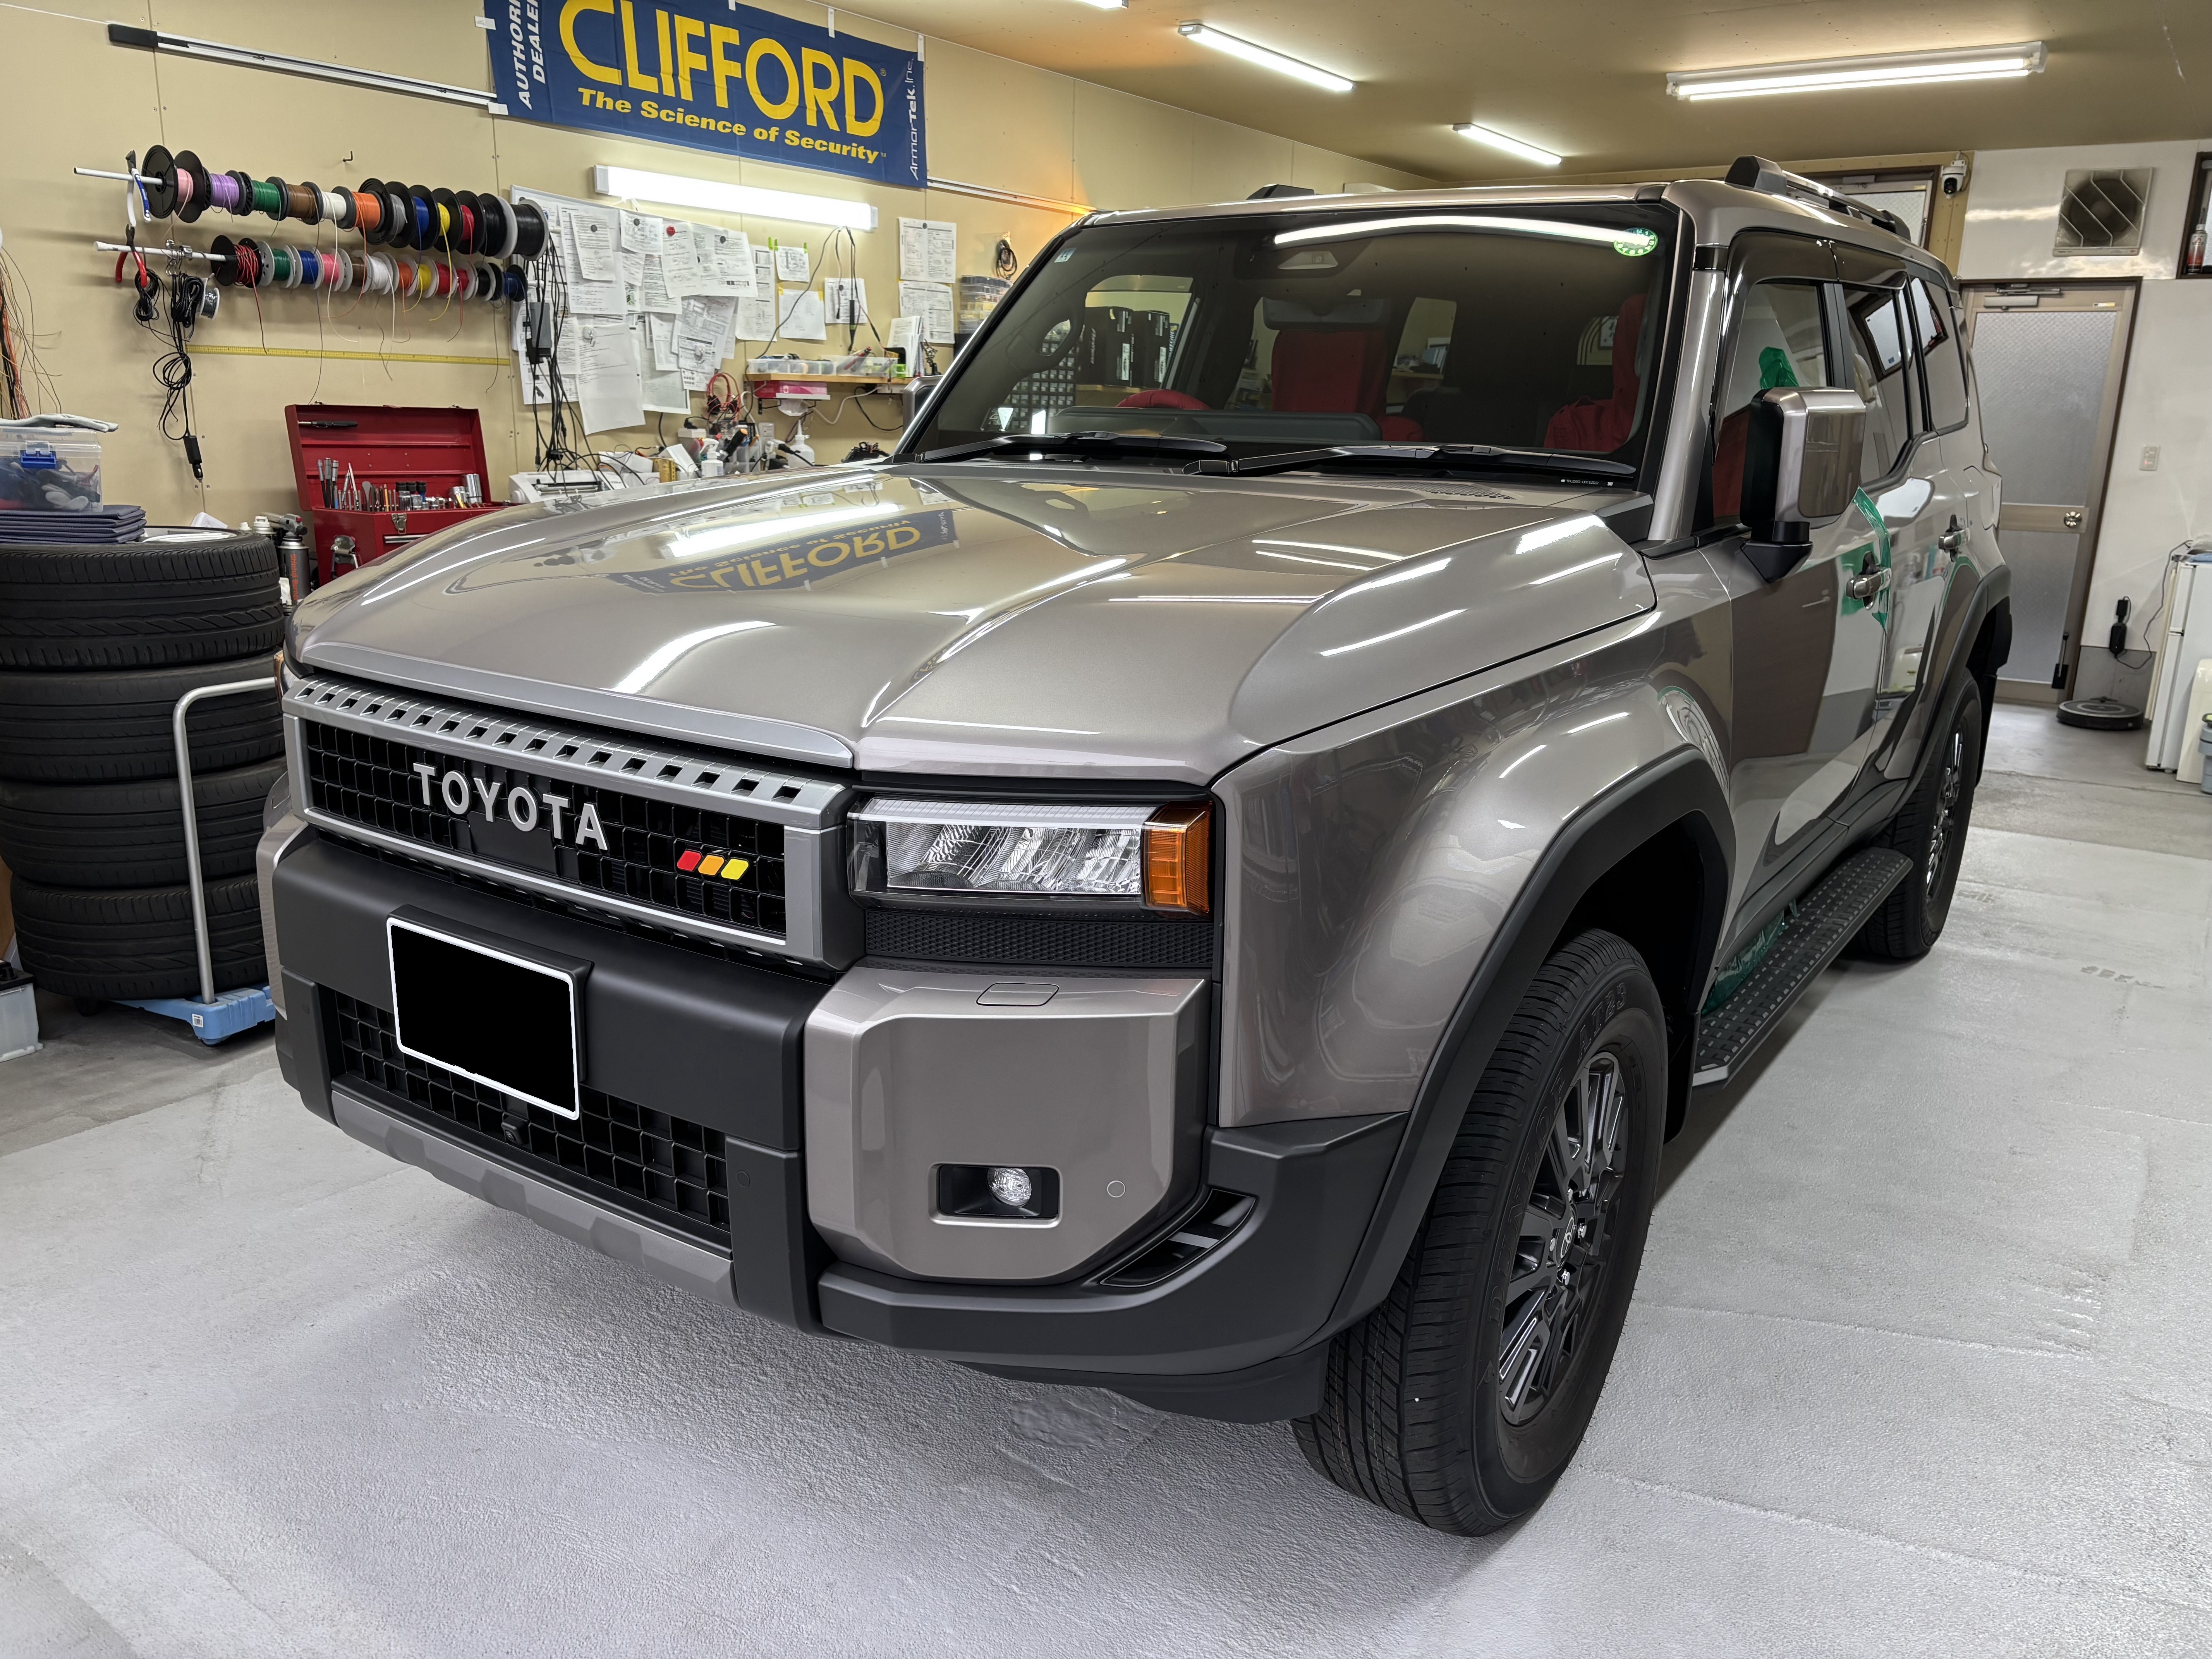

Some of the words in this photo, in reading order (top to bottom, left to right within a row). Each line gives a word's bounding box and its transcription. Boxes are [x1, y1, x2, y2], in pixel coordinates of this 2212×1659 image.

[560, 0, 884, 137] CLIFFORD
[578, 88, 631, 113] The
[641, 101, 746, 136] Science
[754, 127, 779, 142] of
[785, 130, 879, 163] Security
[413, 763, 608, 850] TOYOTA
